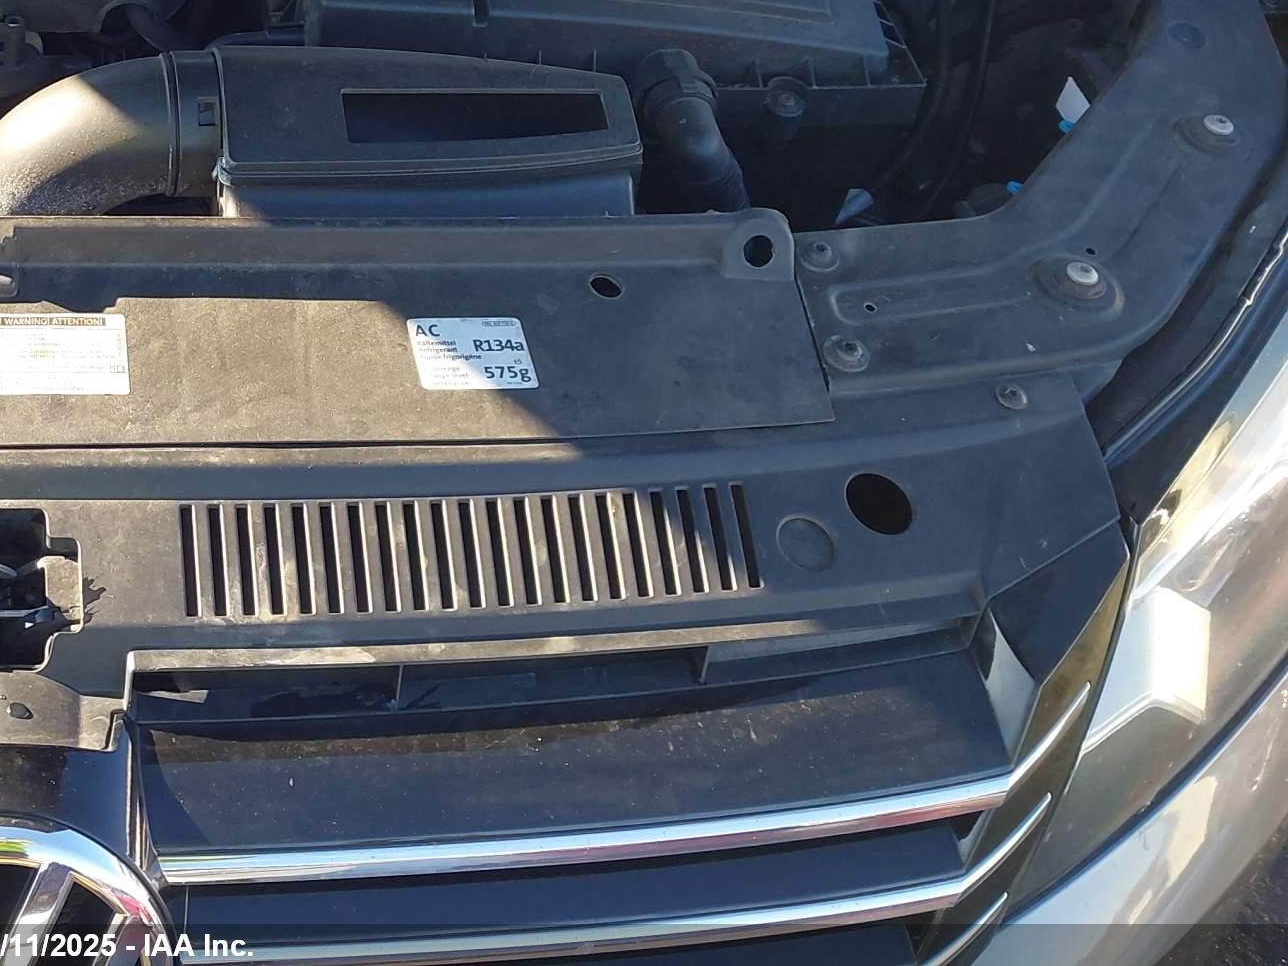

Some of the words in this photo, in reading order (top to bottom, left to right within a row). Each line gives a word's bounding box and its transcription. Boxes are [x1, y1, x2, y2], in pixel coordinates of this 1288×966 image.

[51, 317, 103, 325] ATTENTION!
[415, 324, 441, 337] AC
[472, 339, 525, 352] R134a
[484, 365, 532, 383] 575g
